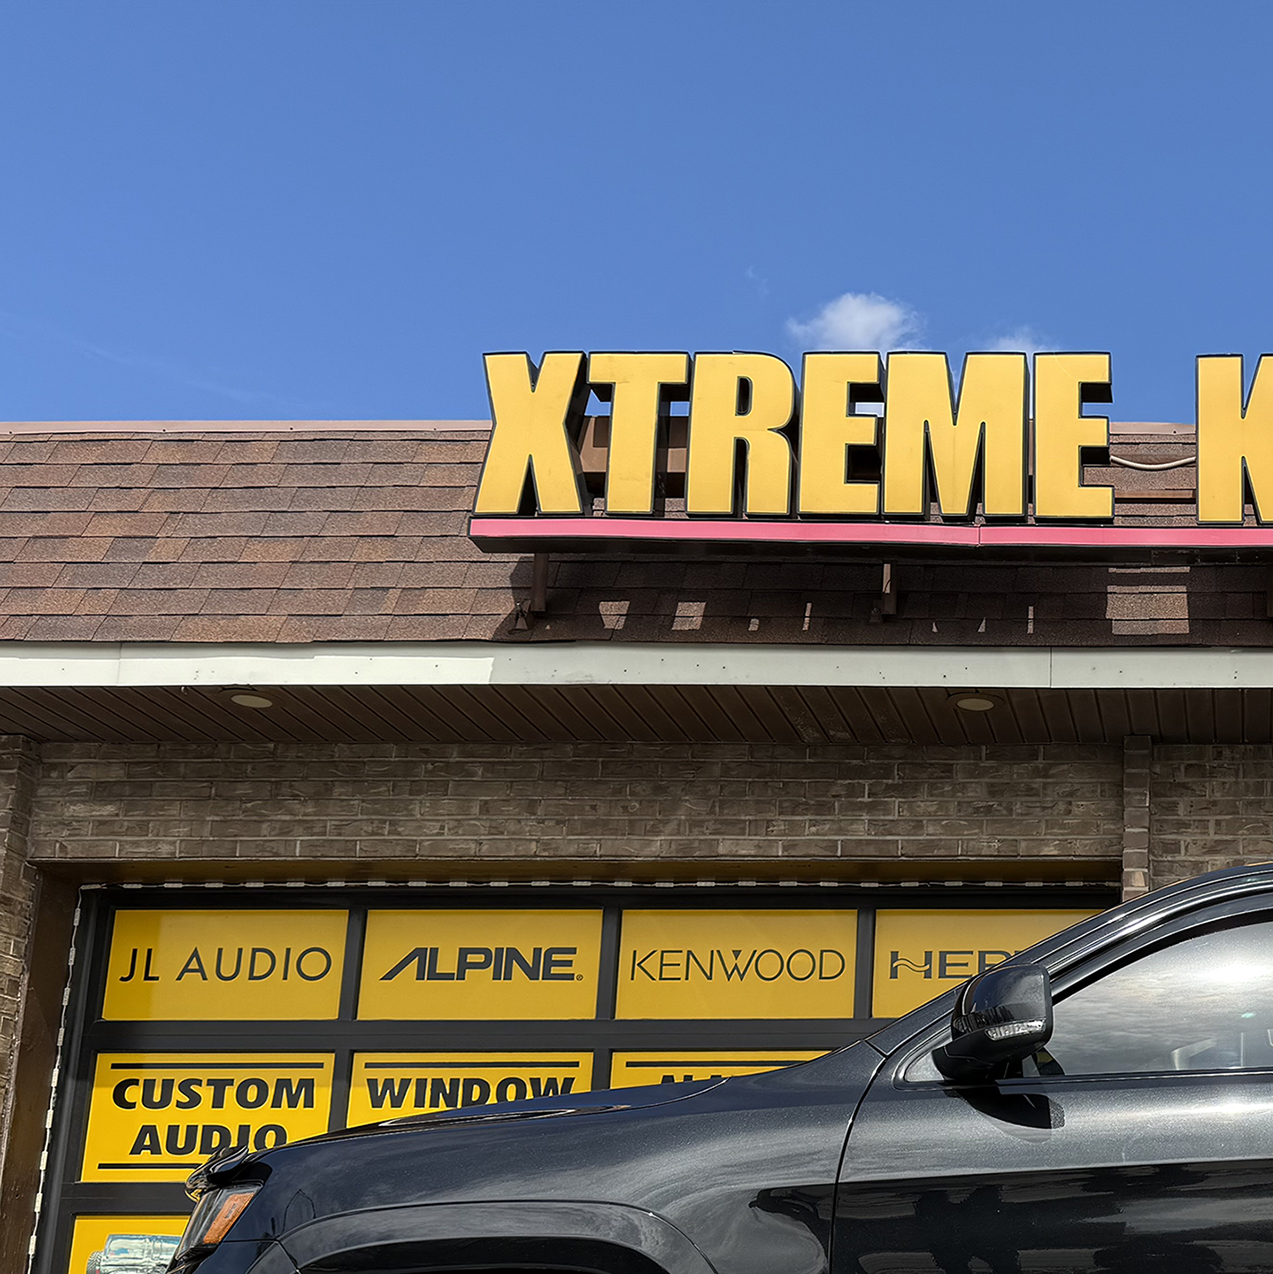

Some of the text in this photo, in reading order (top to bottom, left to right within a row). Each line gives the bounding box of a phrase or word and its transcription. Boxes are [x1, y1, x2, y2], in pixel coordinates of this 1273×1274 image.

[472, 351, 1116, 522] XTREME
[119, 946, 333, 982] JL AUDIO
[379, 946, 578, 981] ALPINE
[630, 948, 846, 981] KENWOOD
[112, 1077, 315, 1110] CUSTOM
[366, 1077, 576, 1109] WINDOW
[128, 1123, 287, 1156] AUDIO
